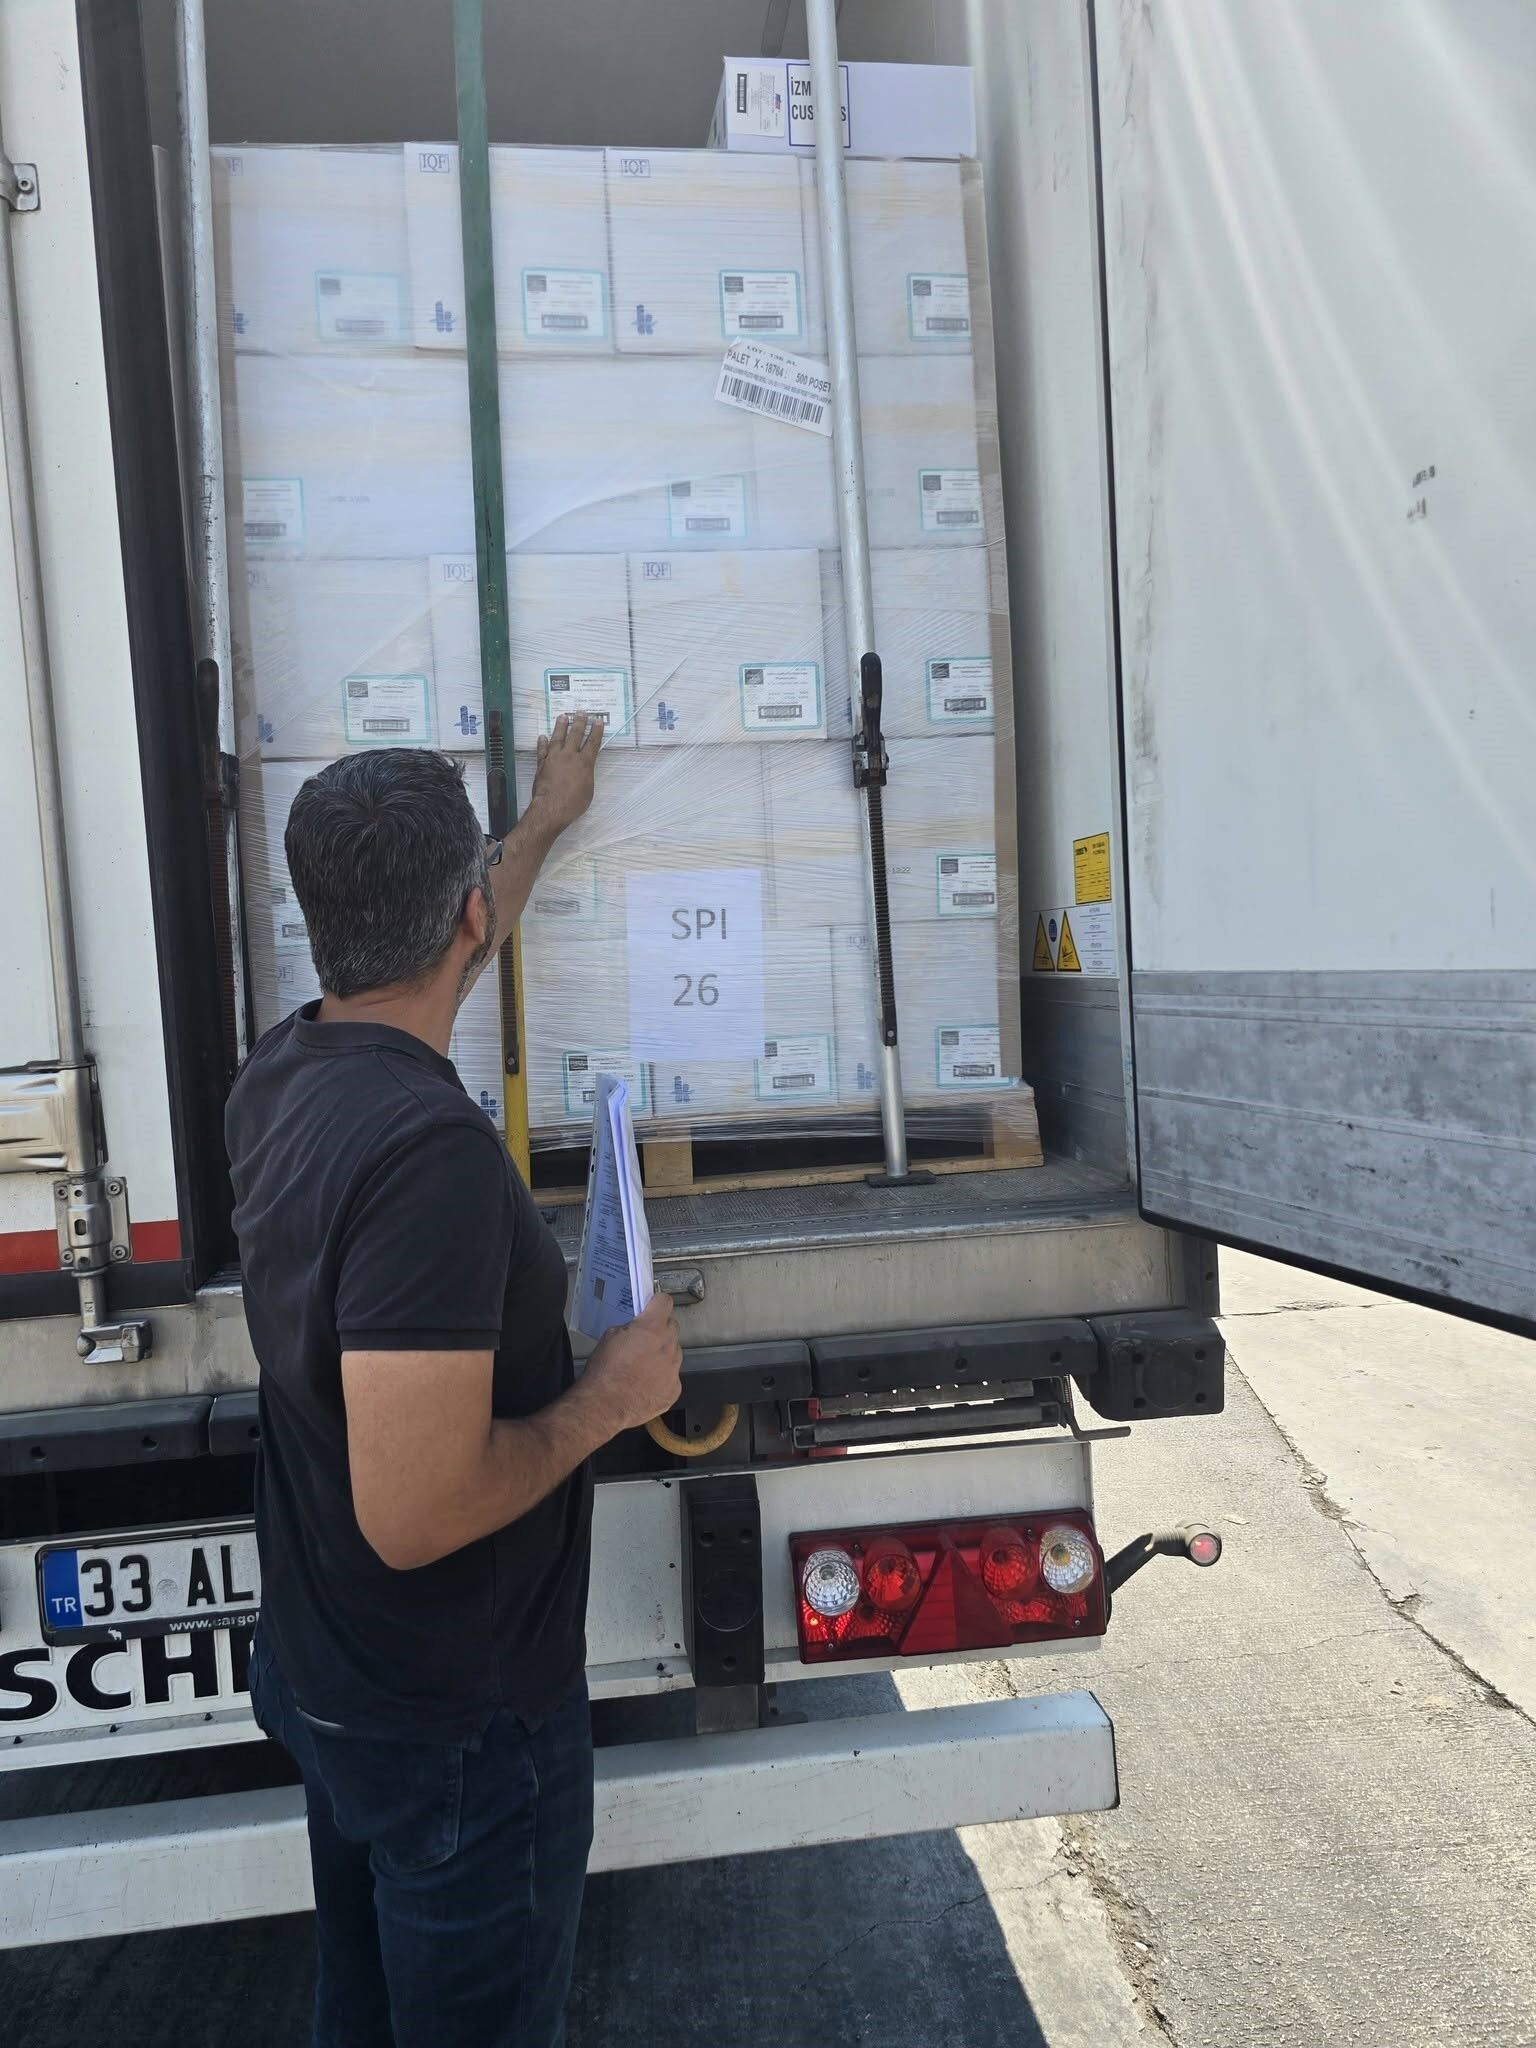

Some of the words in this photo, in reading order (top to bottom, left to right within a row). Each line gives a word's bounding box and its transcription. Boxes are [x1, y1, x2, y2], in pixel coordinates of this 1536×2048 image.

[791, 105, 847, 122] CUSS
[421, 153, 448, 171] IQF
[727, 350, 750, 366] PALET
[796, 373, 808, 386] 500
[645, 562, 669, 577] IQF
[671, 907, 727, 940] SPI
[673, 973, 719, 1007] 26
[80, 1554, 152, 1617] 33
[51, 1596, 78, 1614] TR
